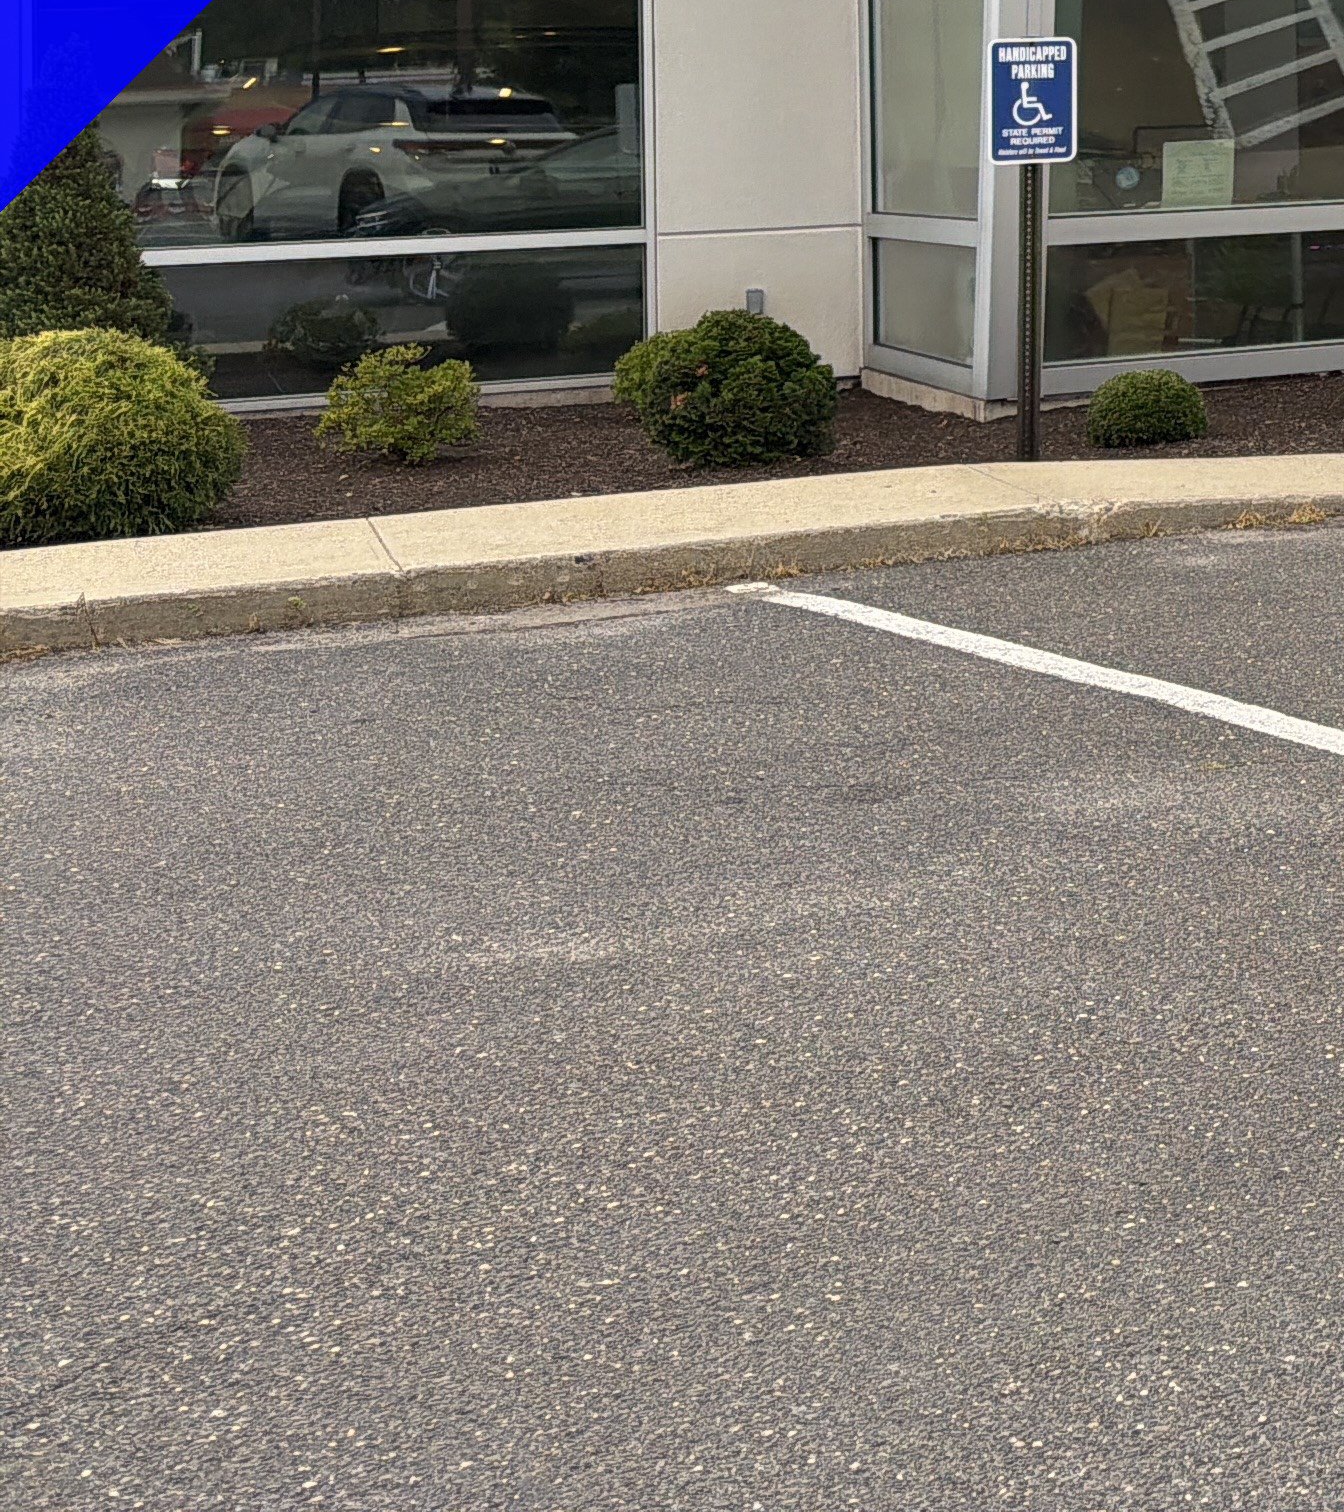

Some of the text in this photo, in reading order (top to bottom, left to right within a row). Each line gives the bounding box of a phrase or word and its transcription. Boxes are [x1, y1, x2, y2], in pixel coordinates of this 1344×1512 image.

[998, 45, 1067, 62] HANDICAPPED
[1011, 63, 1055, 80] PARKING
[1002, 126, 1064, 137] STATE PERMIT
[1010, 136, 1055, 145] REQUIRED
